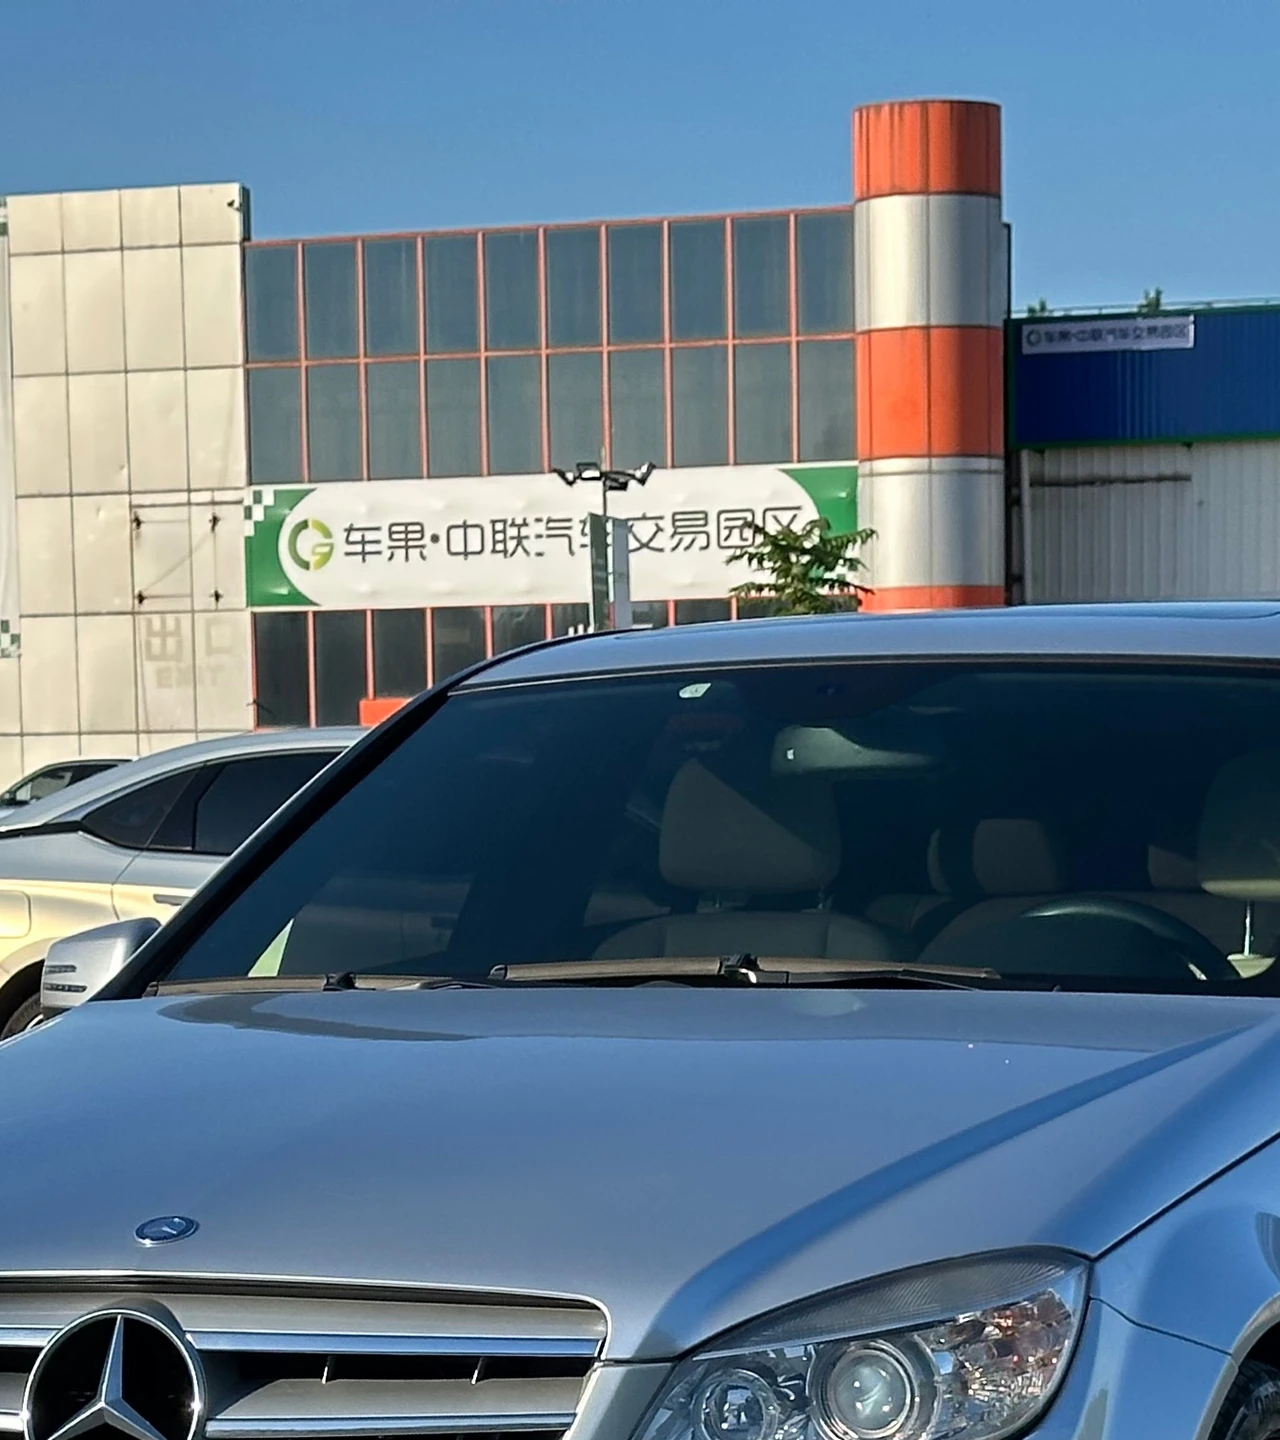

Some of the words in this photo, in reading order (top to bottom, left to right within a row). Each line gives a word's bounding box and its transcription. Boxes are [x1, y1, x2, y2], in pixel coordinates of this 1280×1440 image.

[343, 505, 804, 564] 车果·中联汽交易园区
